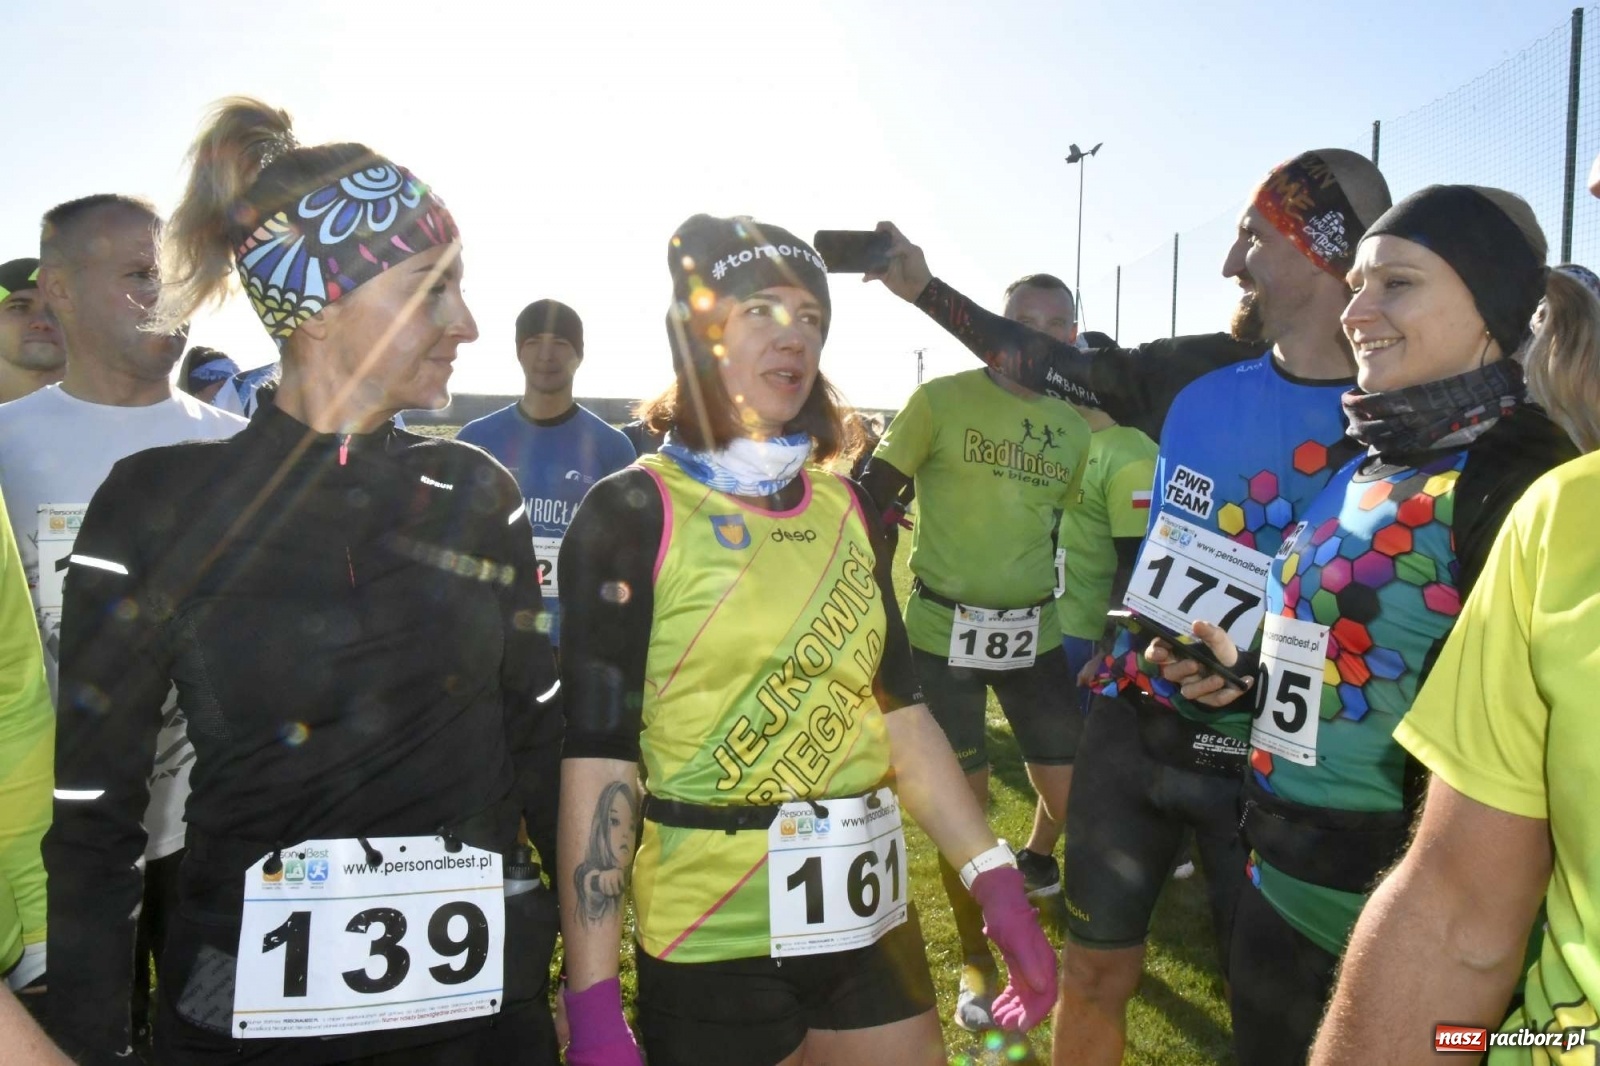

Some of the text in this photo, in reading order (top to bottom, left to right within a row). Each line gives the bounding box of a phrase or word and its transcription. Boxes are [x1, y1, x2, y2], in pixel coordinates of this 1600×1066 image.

[992, 469, 1004, 477] w
[1174, 468, 1211, 497] PWR
[1166, 484, 1210, 516] TEAM
[1147, 554, 1262, 633] 177
[959, 629, 1034, 660] 182
[787, 838, 900, 925] 161
[262, 900, 490, 998] 139
